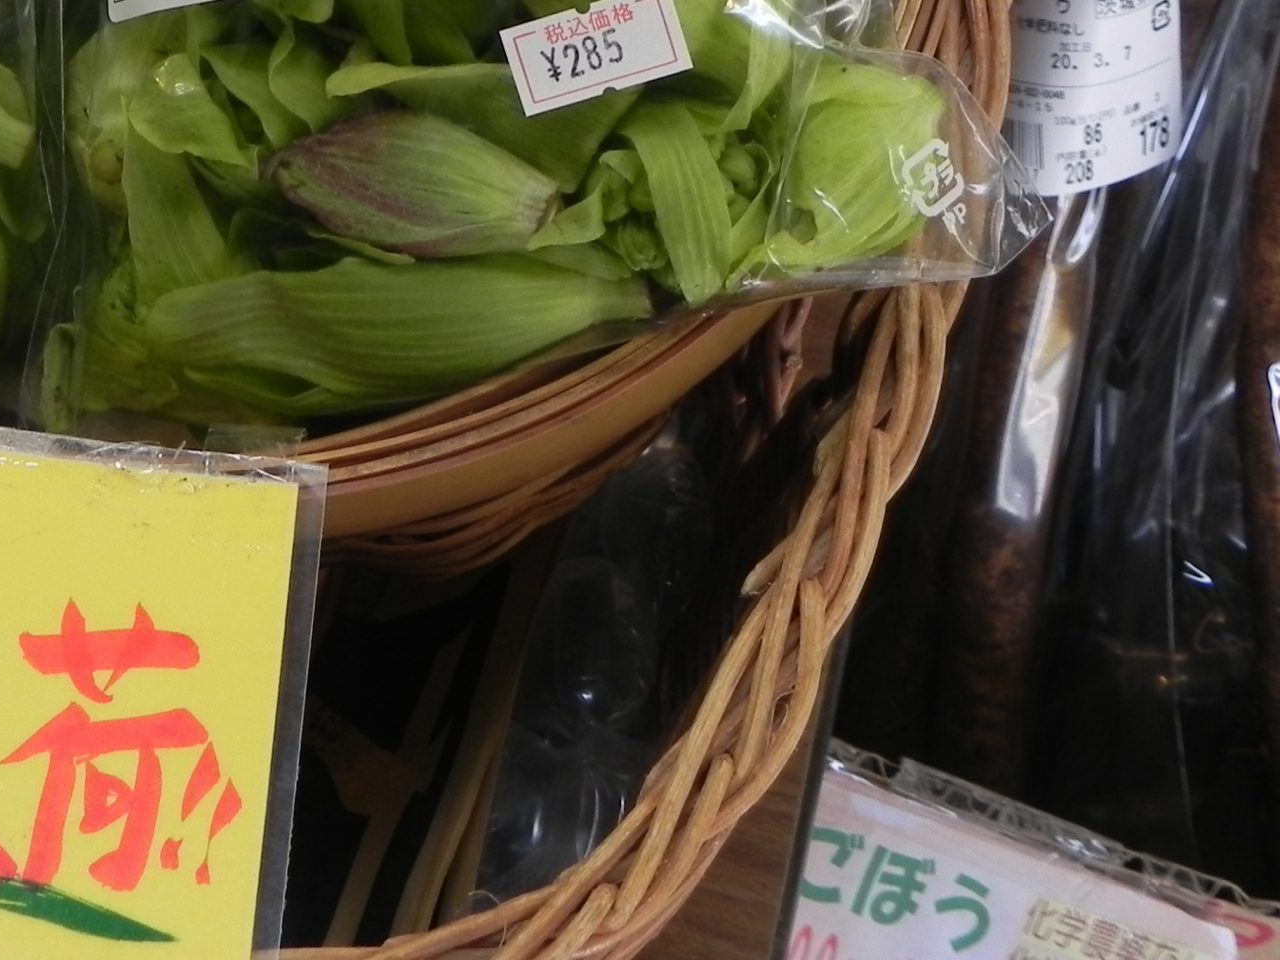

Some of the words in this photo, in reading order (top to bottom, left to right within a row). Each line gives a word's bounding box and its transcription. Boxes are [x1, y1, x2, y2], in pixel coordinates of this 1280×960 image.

[543, 2, 635, 45] 税込価格
[540, 27, 624, 82] ¥285
[1139, 114, 1171, 157] 178
[1065, 159, 1095, 185] 208
[800, 826, 991, 953] ごぼう
